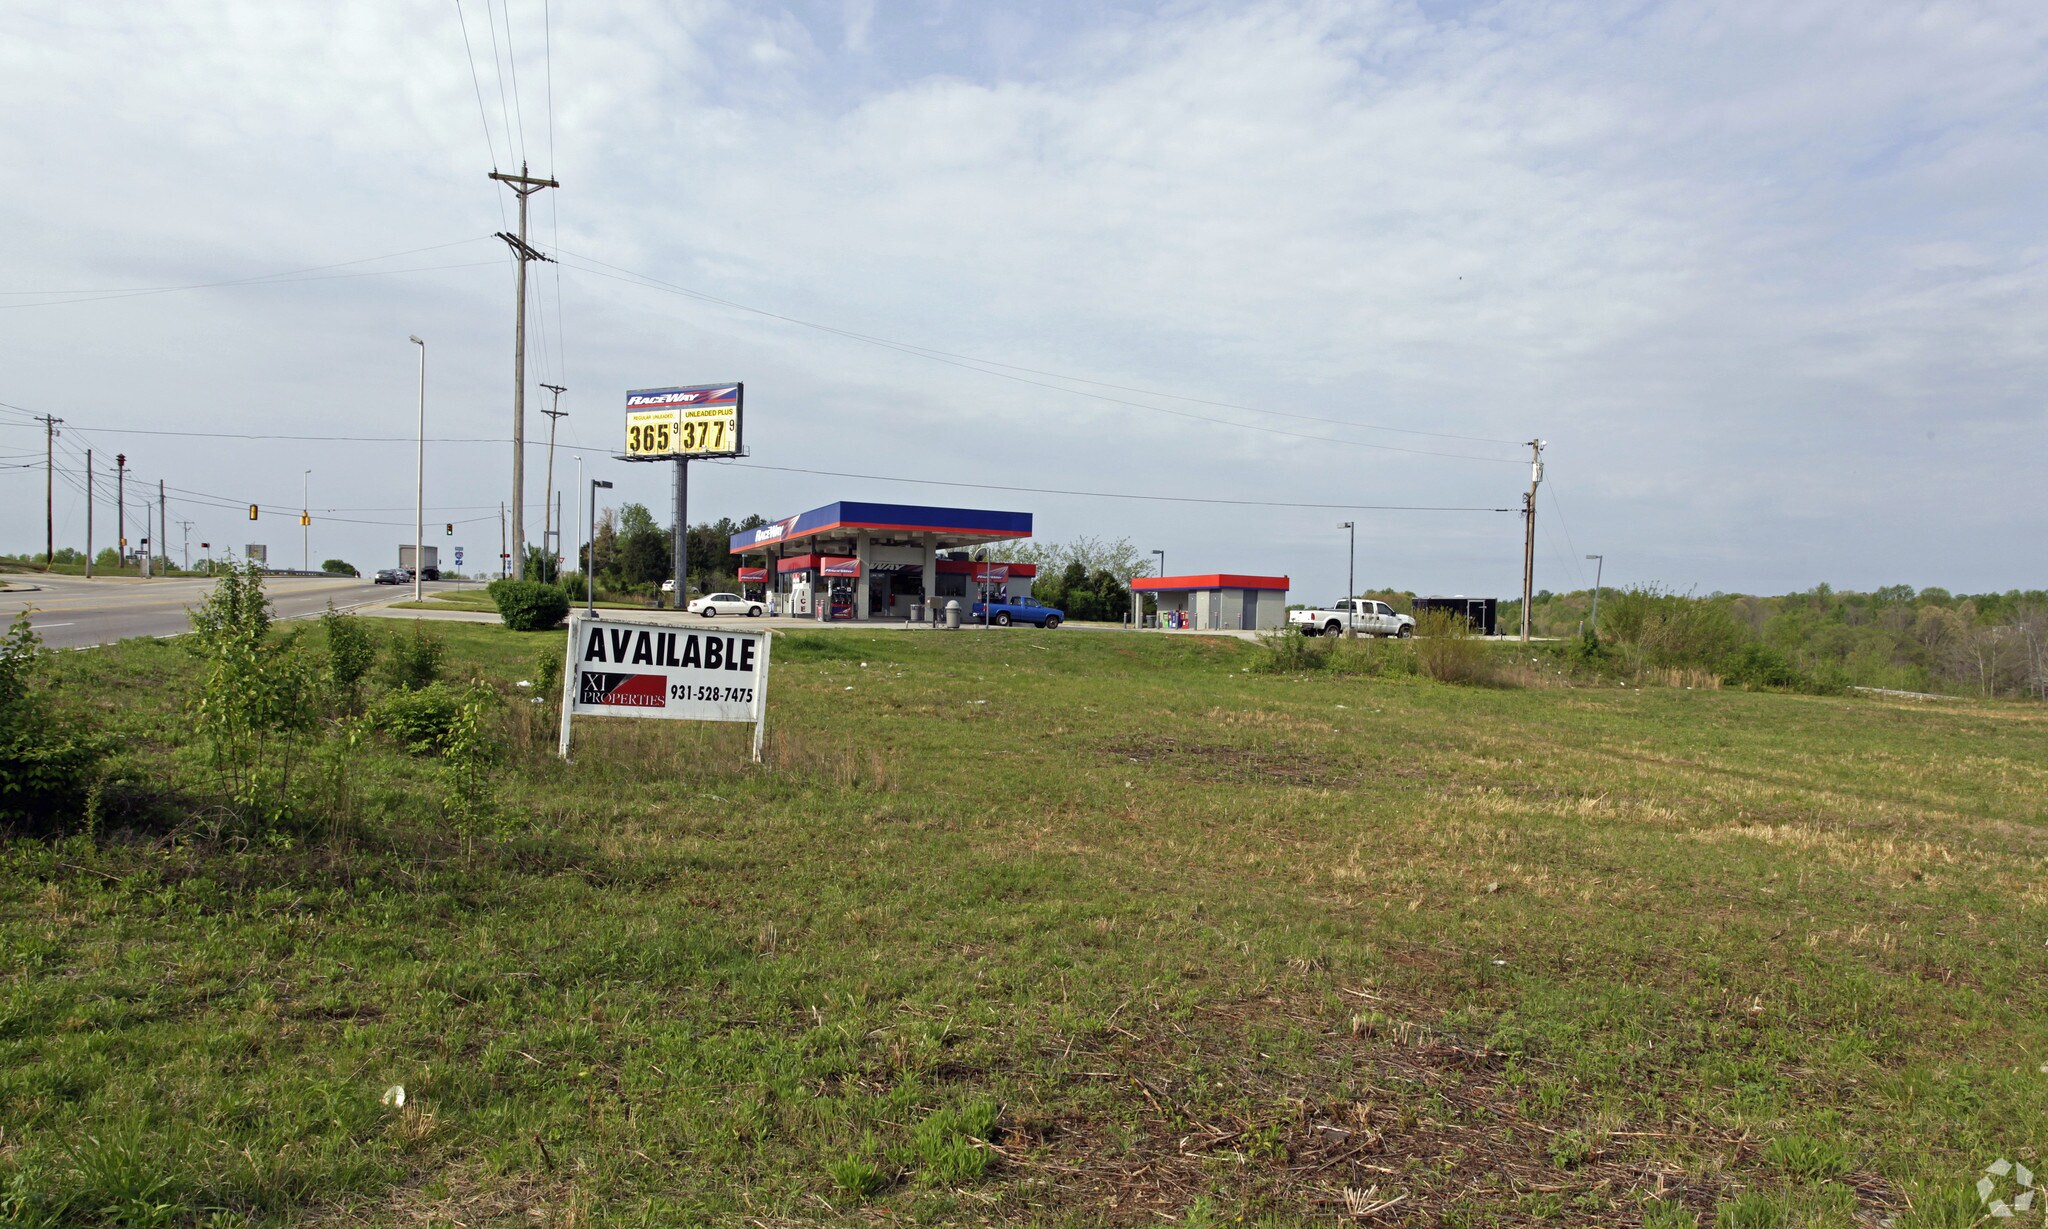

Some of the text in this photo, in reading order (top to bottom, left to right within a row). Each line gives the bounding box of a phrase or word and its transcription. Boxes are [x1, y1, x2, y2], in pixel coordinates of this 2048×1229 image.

[685, 410, 717, 418] UNLEADED
[630, 425, 668, 451] 365
[684, 422, 724, 448] 377
[584, 627, 756, 672] AVAILABLE
[585, 674, 606, 691] XI
[583, 692, 665, 705] PROPERTIES
[670, 684, 753, 703] 931-528-7475
